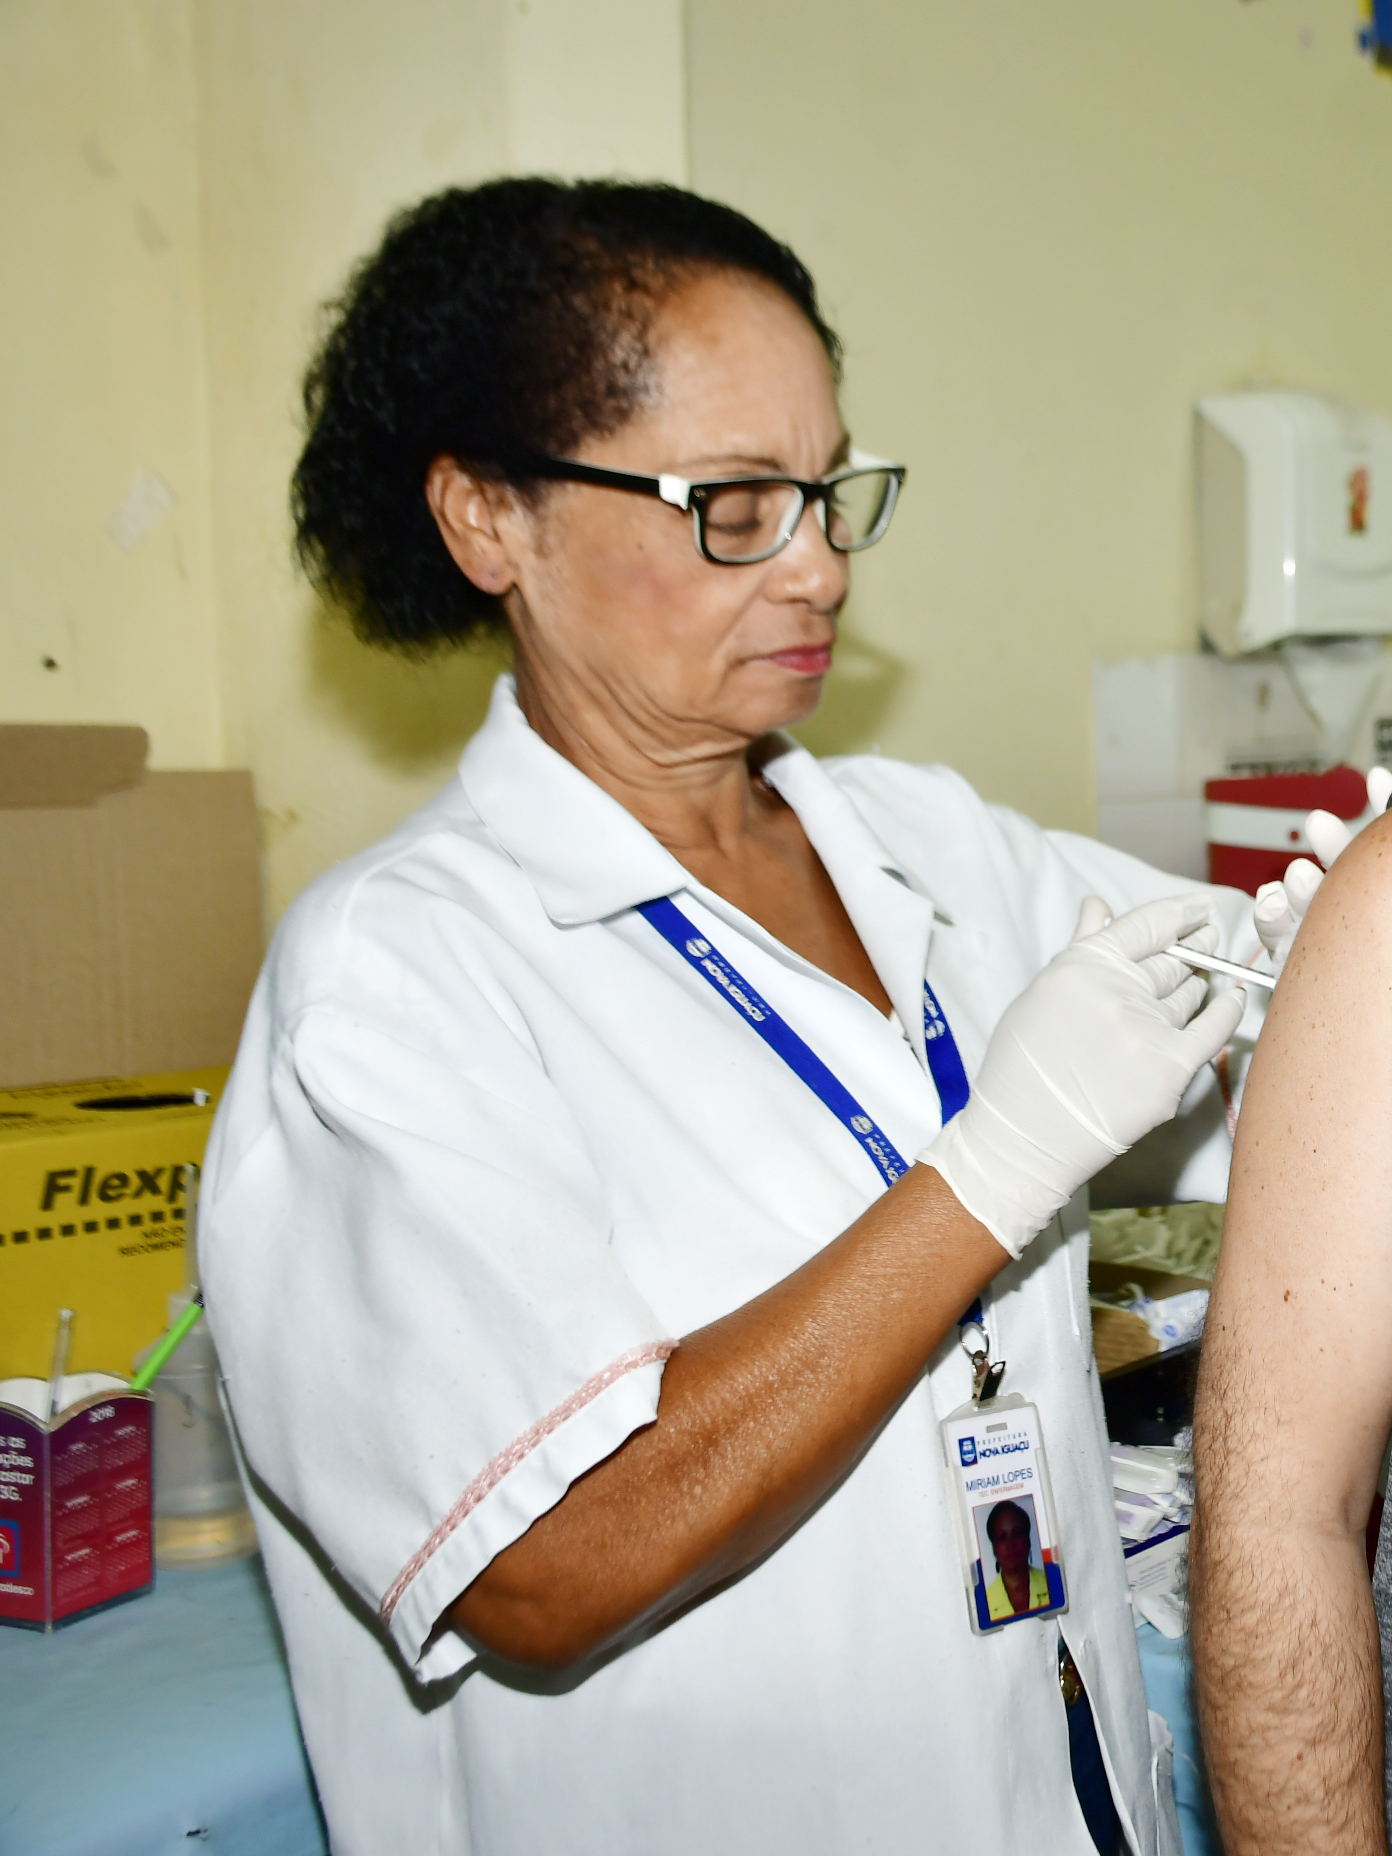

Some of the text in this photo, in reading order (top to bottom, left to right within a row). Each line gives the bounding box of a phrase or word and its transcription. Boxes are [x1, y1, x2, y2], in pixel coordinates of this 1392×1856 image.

[864, 1137, 890, 1170] NOVA
[978, 1440, 1030, 1459] NOVA IGUAÇU
[966, 1467, 1034, 1492] MIRIAM LOPES
